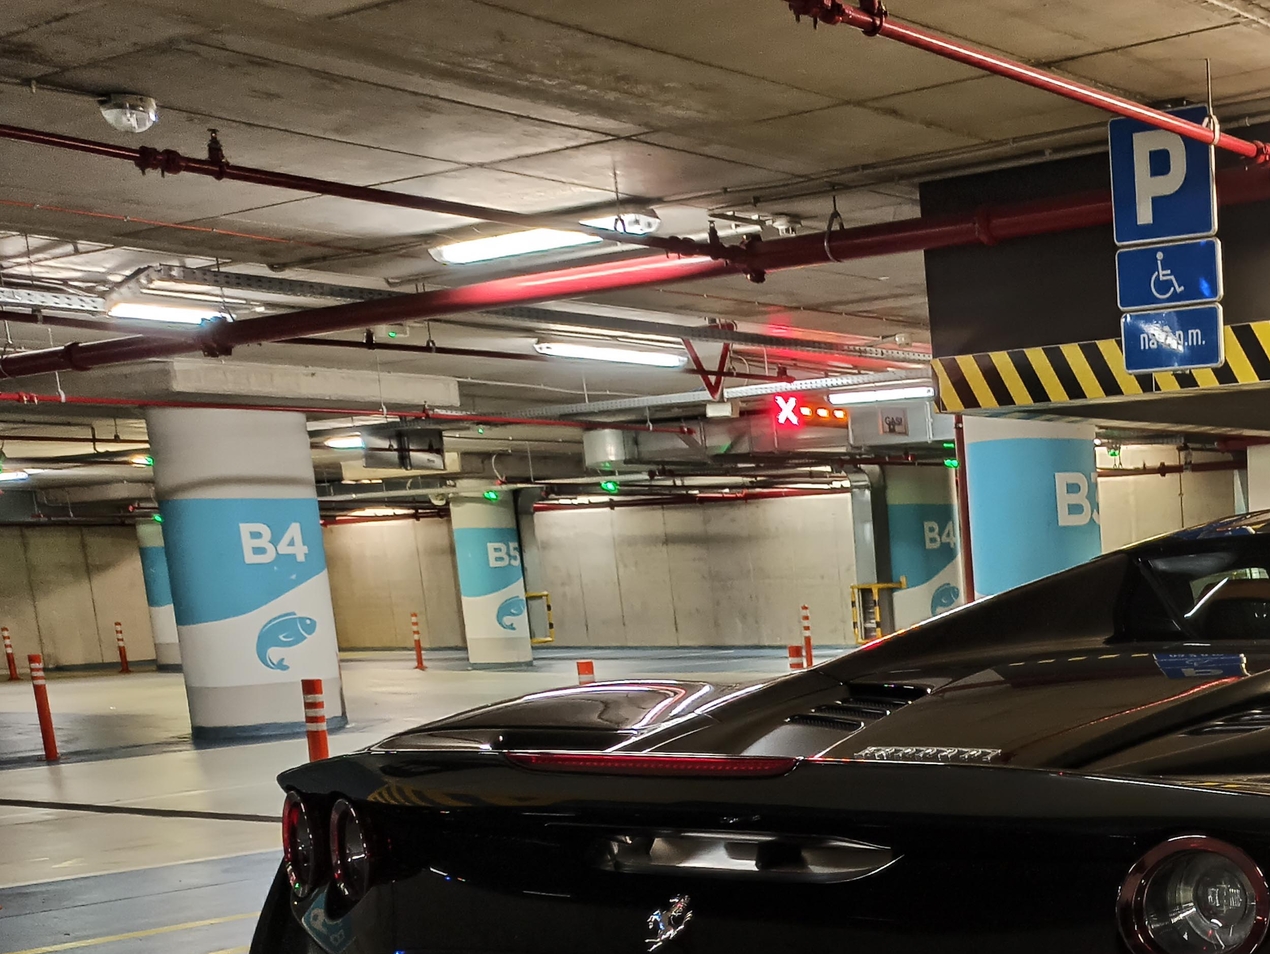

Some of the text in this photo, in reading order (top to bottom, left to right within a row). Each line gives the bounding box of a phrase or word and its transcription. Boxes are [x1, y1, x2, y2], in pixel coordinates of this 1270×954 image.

[1132, 129, 1187, 226] P
[239, 522, 309, 565] B4
[923, 520, 957, 550] B4
[487, 541, 521, 568] B5
